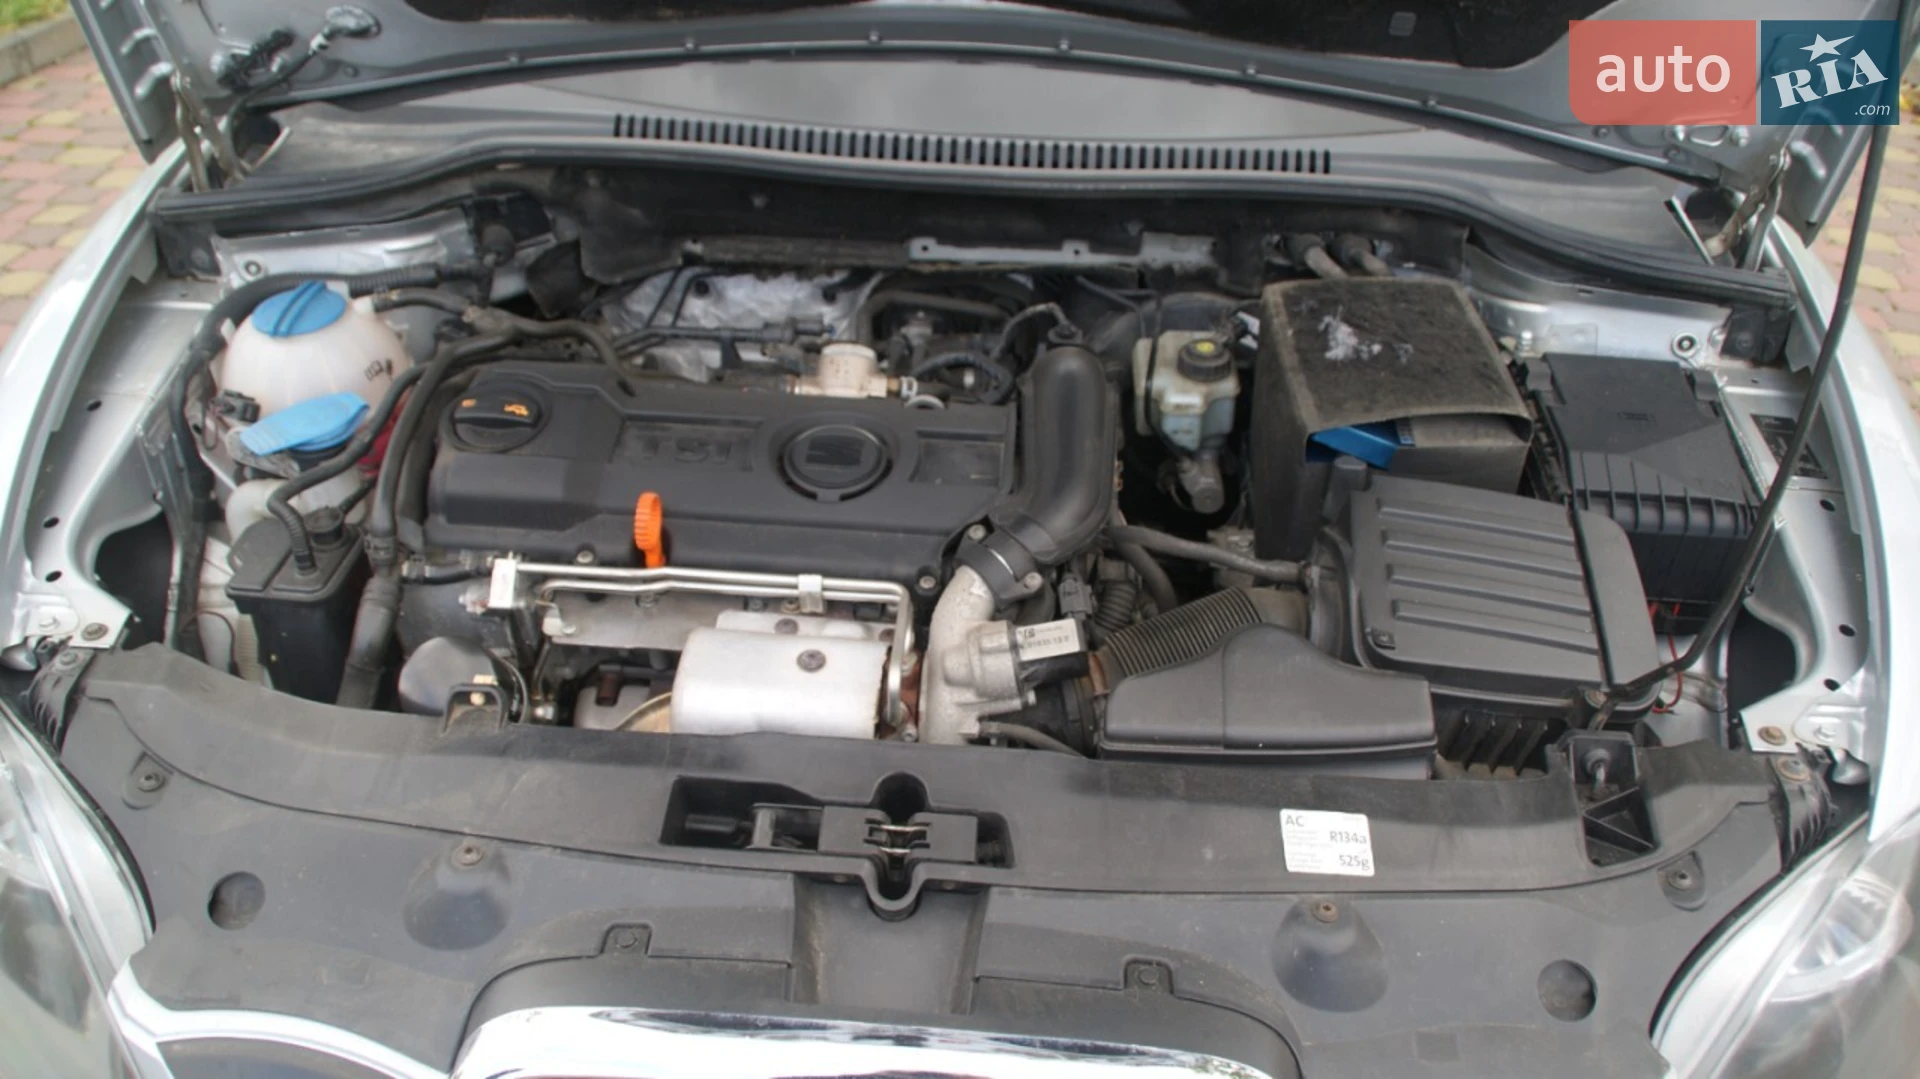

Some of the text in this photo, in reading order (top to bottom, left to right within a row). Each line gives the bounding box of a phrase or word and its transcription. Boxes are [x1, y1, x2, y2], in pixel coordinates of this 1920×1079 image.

[1285, 815, 1305, 827] AC
[1329, 831, 1368, 844] R134a
[1338, 855, 1370, 871] 525g
